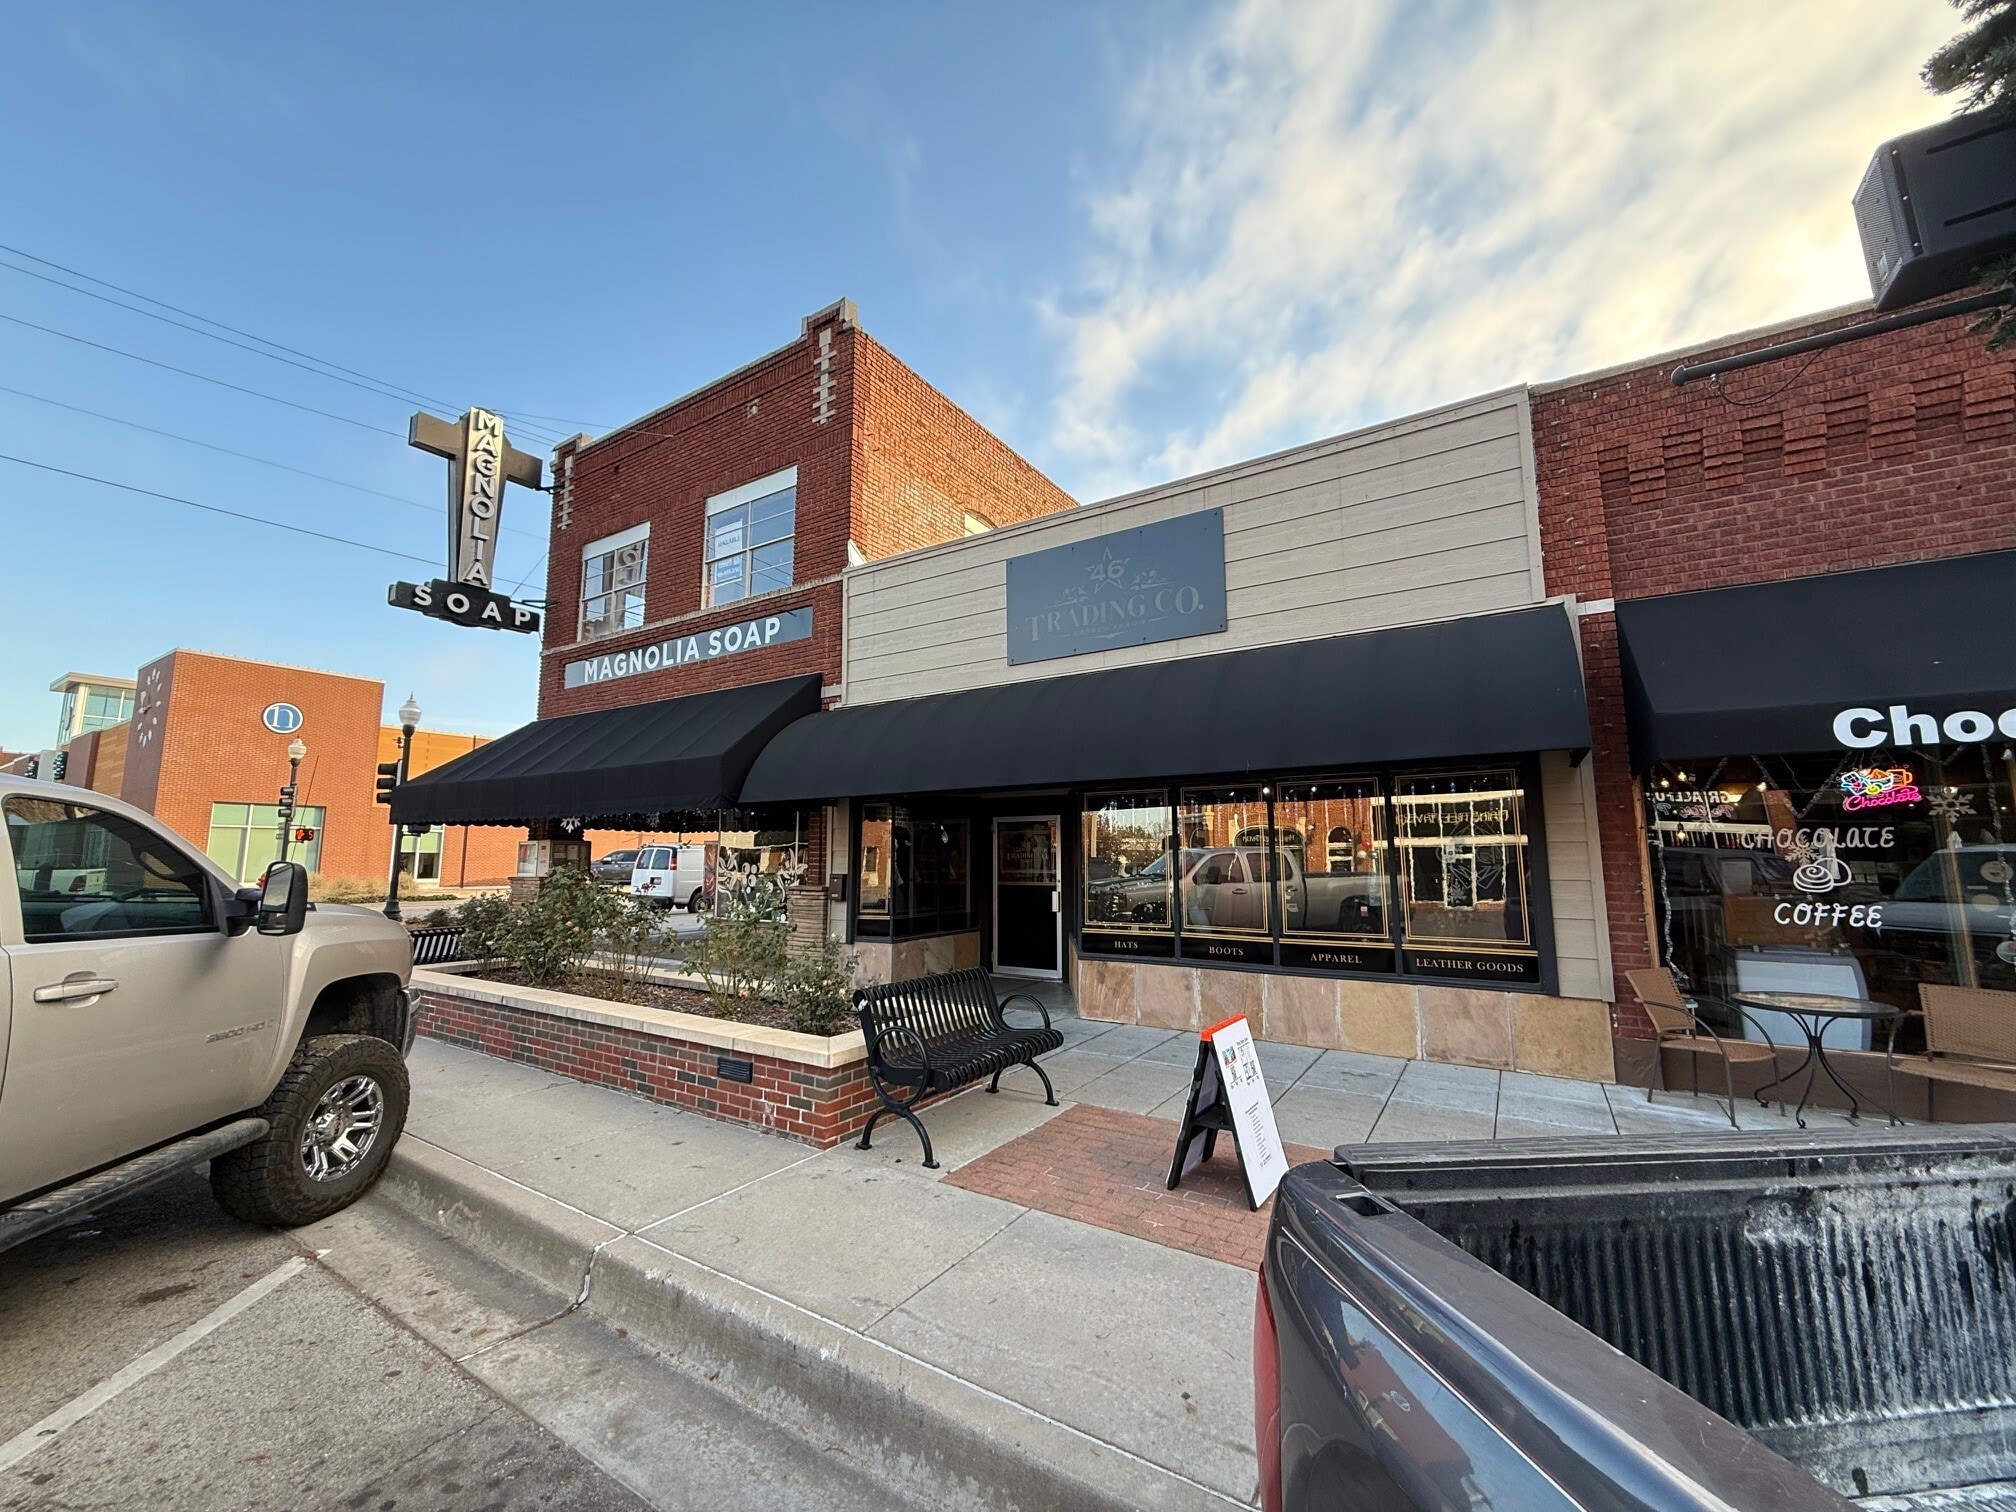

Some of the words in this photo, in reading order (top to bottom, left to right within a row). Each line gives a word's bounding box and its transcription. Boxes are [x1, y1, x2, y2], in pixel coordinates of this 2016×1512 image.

[466, 409, 500, 585] MAGNOLIA
[1091, 558, 1124, 581] 46
[413, 585, 531, 626] SOAP
[1025, 594, 1145, 642] TRADING
[1154, 585, 1204, 614] CO.
[584, 636, 700, 683] MAGNOLIA
[708, 616, 782, 656] SOAP
[1845, 788, 1922, 811] Chocolate
[1741, 827, 1895, 850] CHOCOLATE
[1774, 903, 1884, 928] COFFEE
[1114, 940, 1139, 950] HATS
[1209, 946, 1244, 956] BOOTS
[1310, 953, 1363, 964] APPAREL
[1416, 958, 1473, 970] LEATHER
[1477, 961, 1524, 973] GOODS
